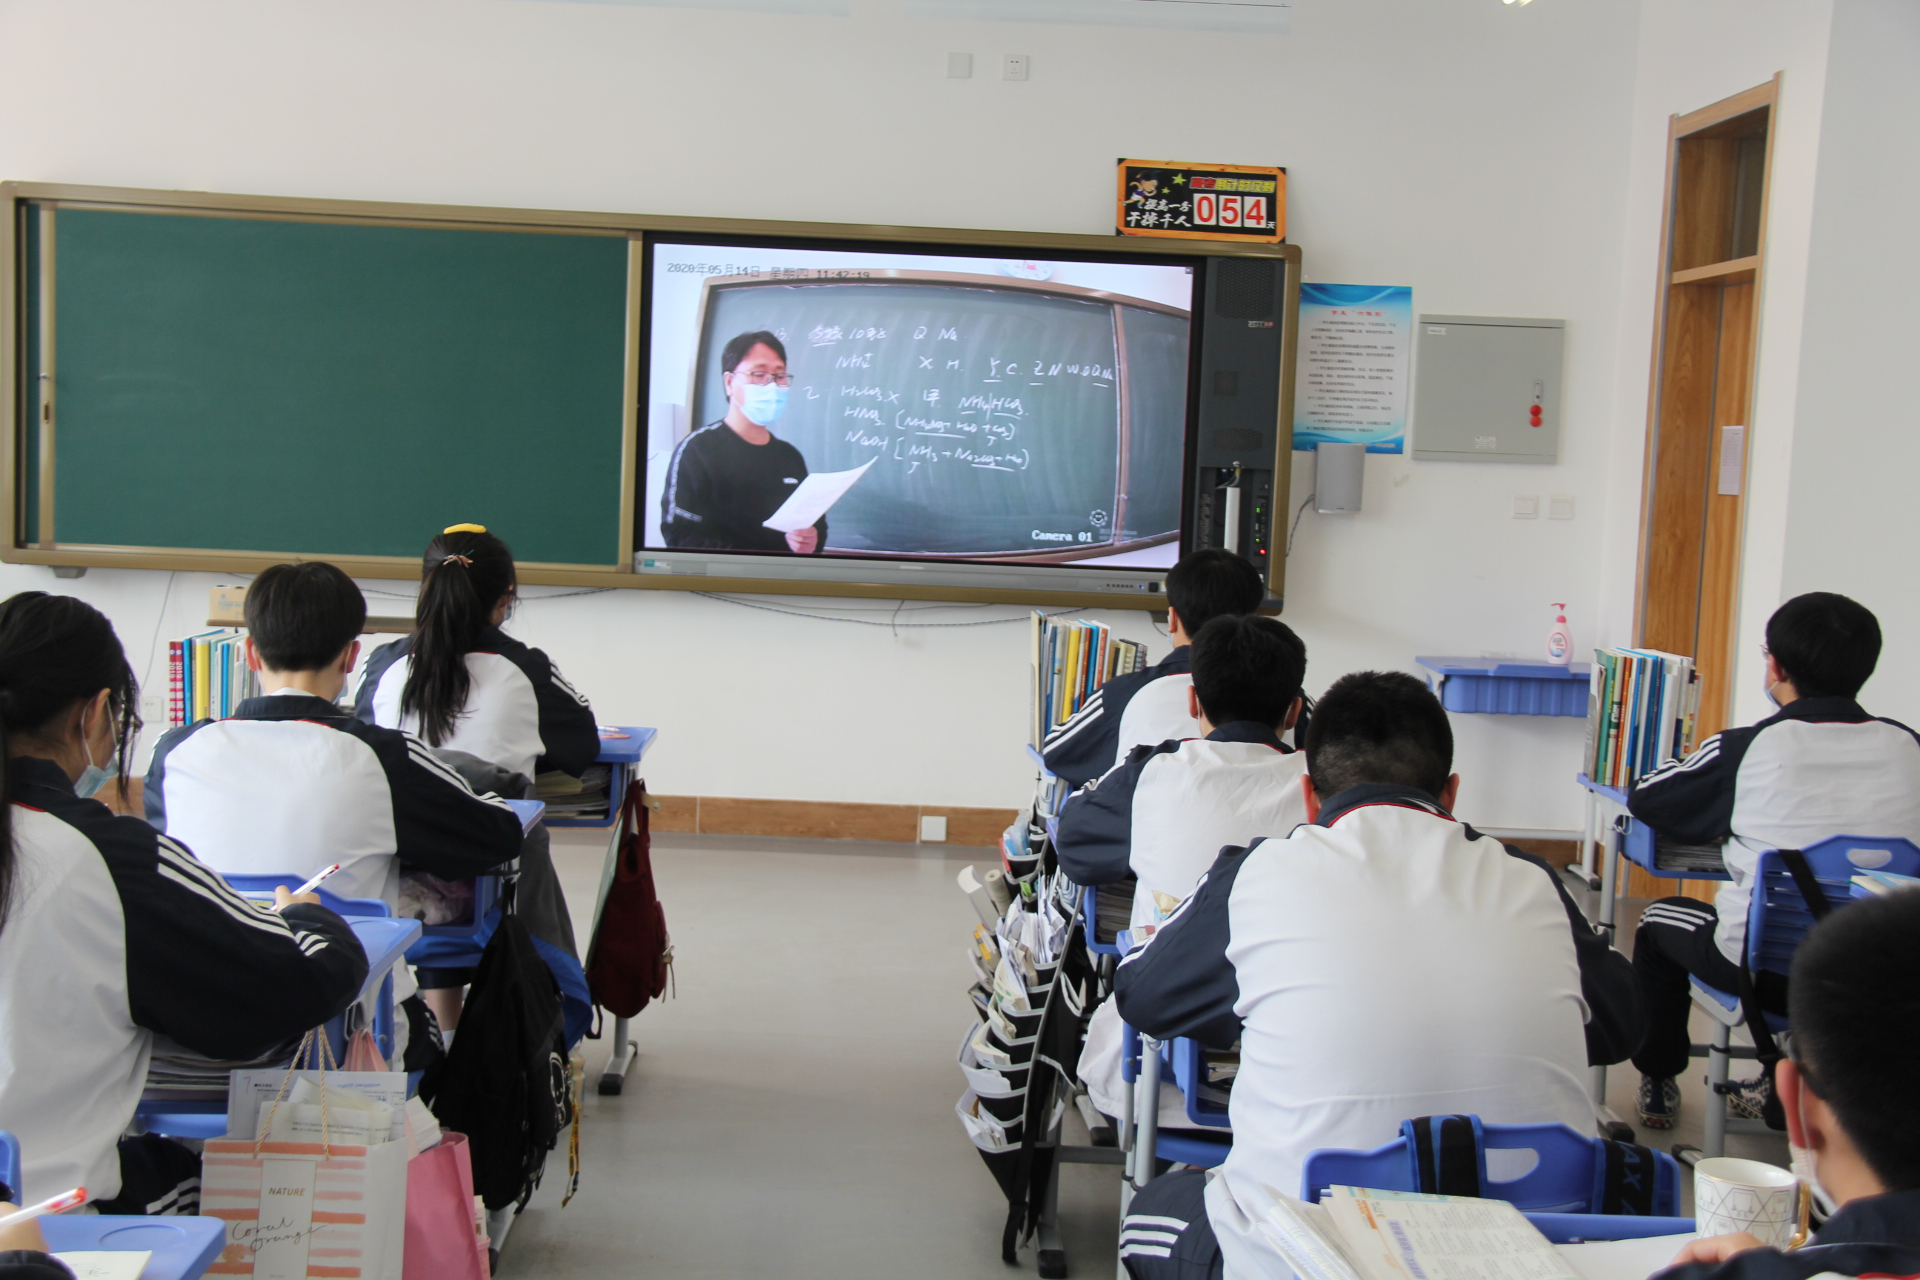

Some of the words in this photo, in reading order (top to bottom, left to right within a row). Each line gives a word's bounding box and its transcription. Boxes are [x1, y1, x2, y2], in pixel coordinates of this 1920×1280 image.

[1196, 195, 1265, 226] 054
[1126, 211, 1192, 229] 干掉千人
[667, 263, 761, 278] 2020年05月14日
[770, 266, 810, 280] 星期四
[1031, 530, 1073, 542] Camera
[1078, 531, 1093, 542] 01
[268, 1187, 306, 1197] NATURE
